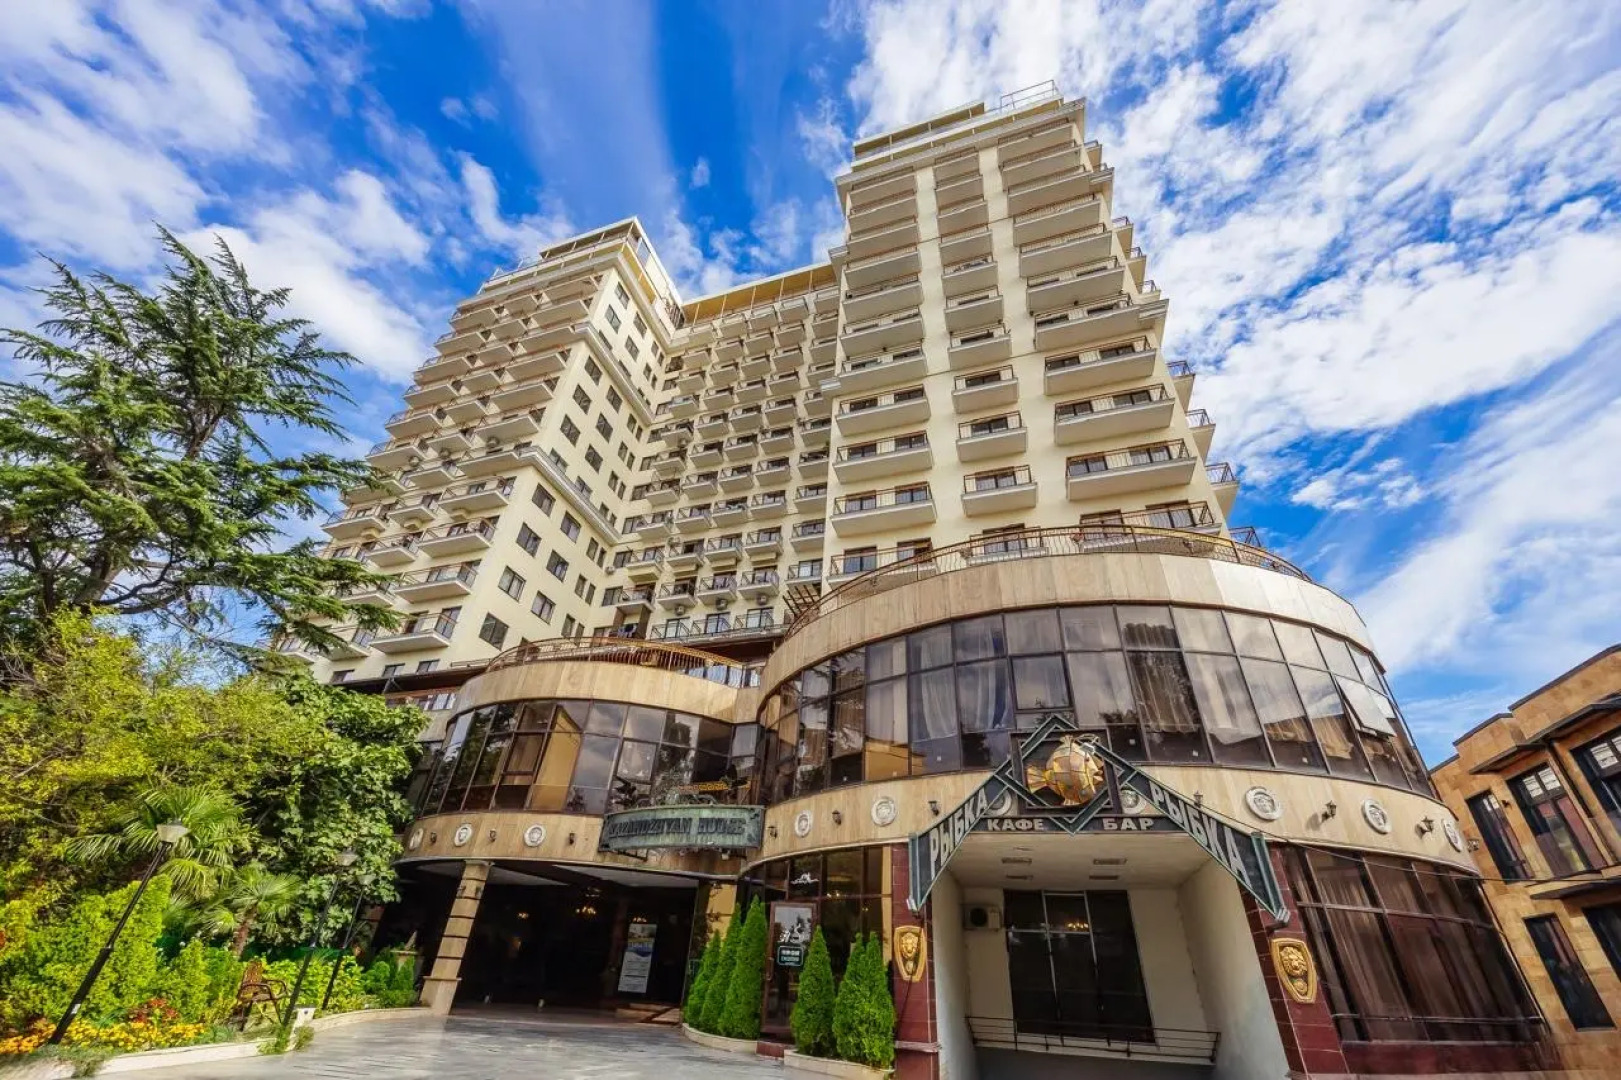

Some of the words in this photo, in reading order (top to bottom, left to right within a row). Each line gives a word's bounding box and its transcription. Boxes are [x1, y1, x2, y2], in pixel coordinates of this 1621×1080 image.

[929, 788, 988, 881] РЫБКА
[987, 818, 1045, 831] КАФЕ
[1102, 817, 1154, 831] БАР
[1149, 780, 1253, 890] РЫБКА
